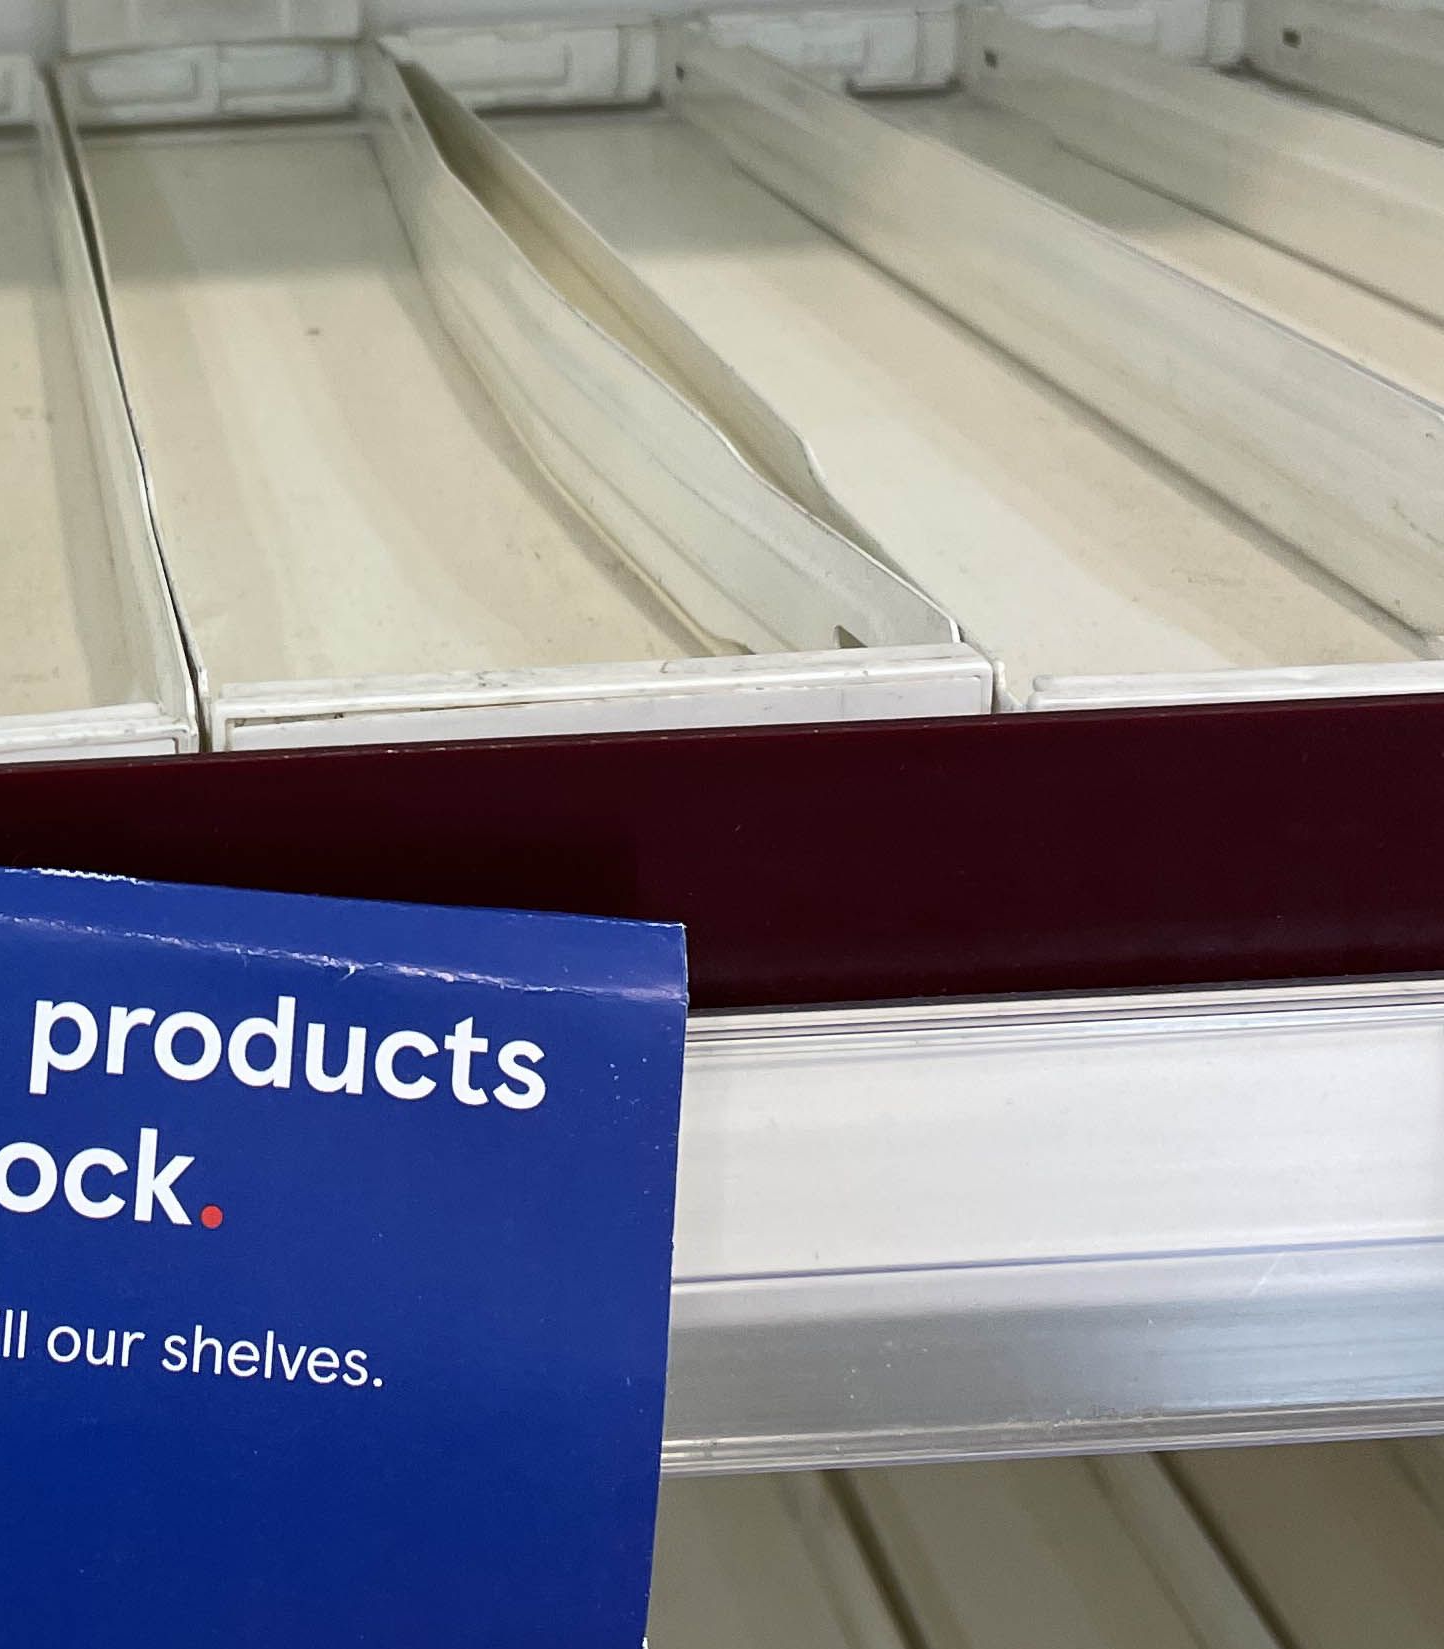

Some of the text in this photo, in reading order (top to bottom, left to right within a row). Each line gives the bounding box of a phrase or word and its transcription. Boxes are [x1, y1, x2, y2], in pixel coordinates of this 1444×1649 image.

[29, 984, 546, 1110] products
[47, 1325, 146, 1367] our
[161, 1324, 384, 1388] shelves.
